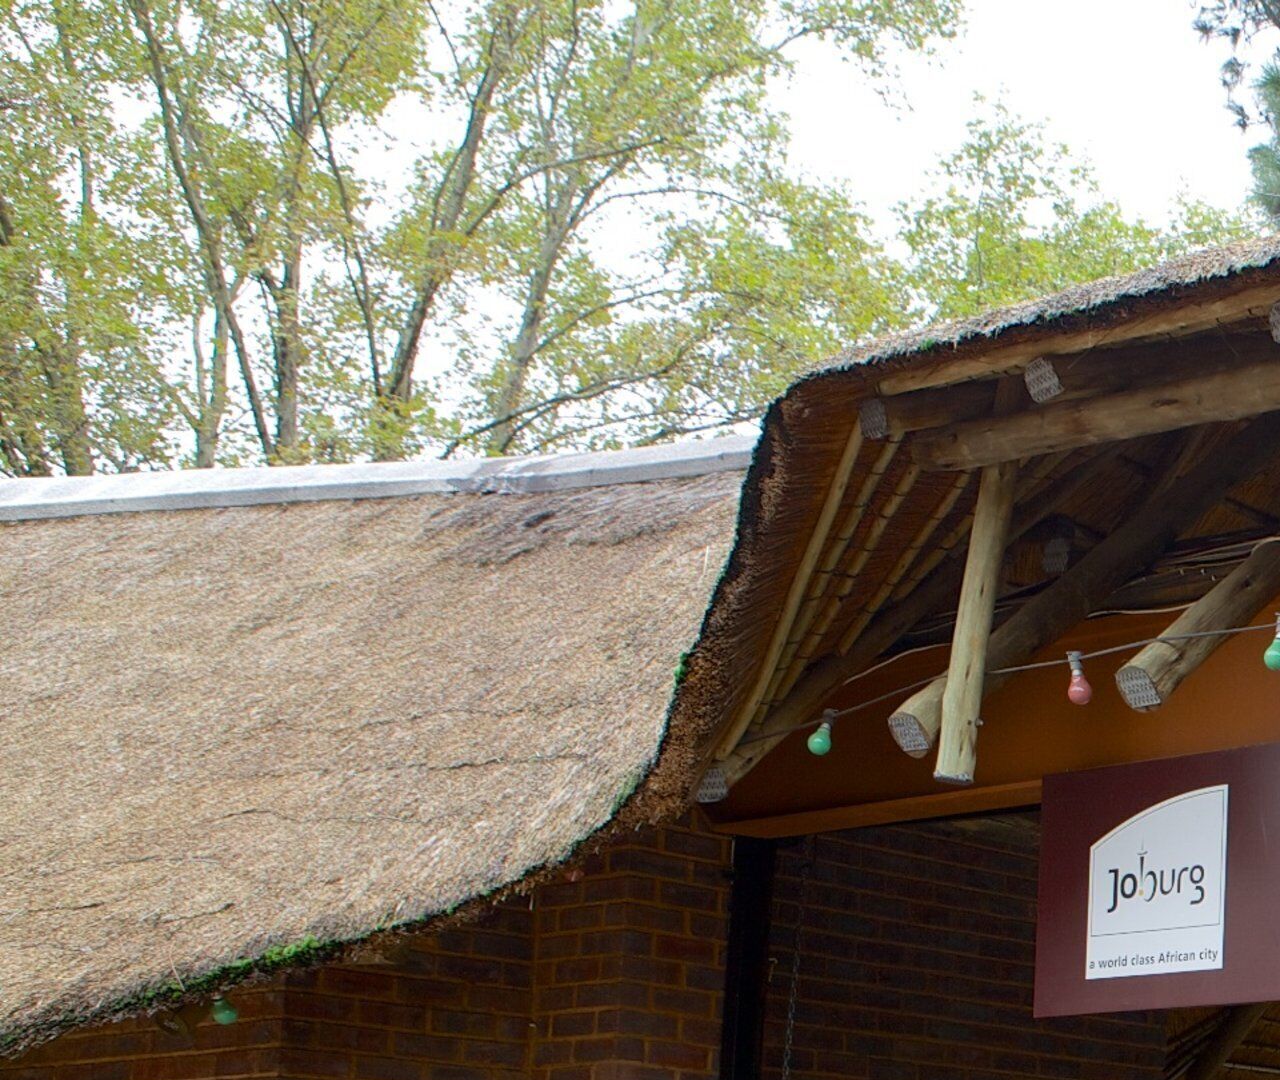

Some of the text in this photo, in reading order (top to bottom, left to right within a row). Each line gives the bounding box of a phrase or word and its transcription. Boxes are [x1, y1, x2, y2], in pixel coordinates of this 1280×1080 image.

[1107, 852, 1205, 912] Joburg
[1089, 948, 1219, 970] a world class African city
